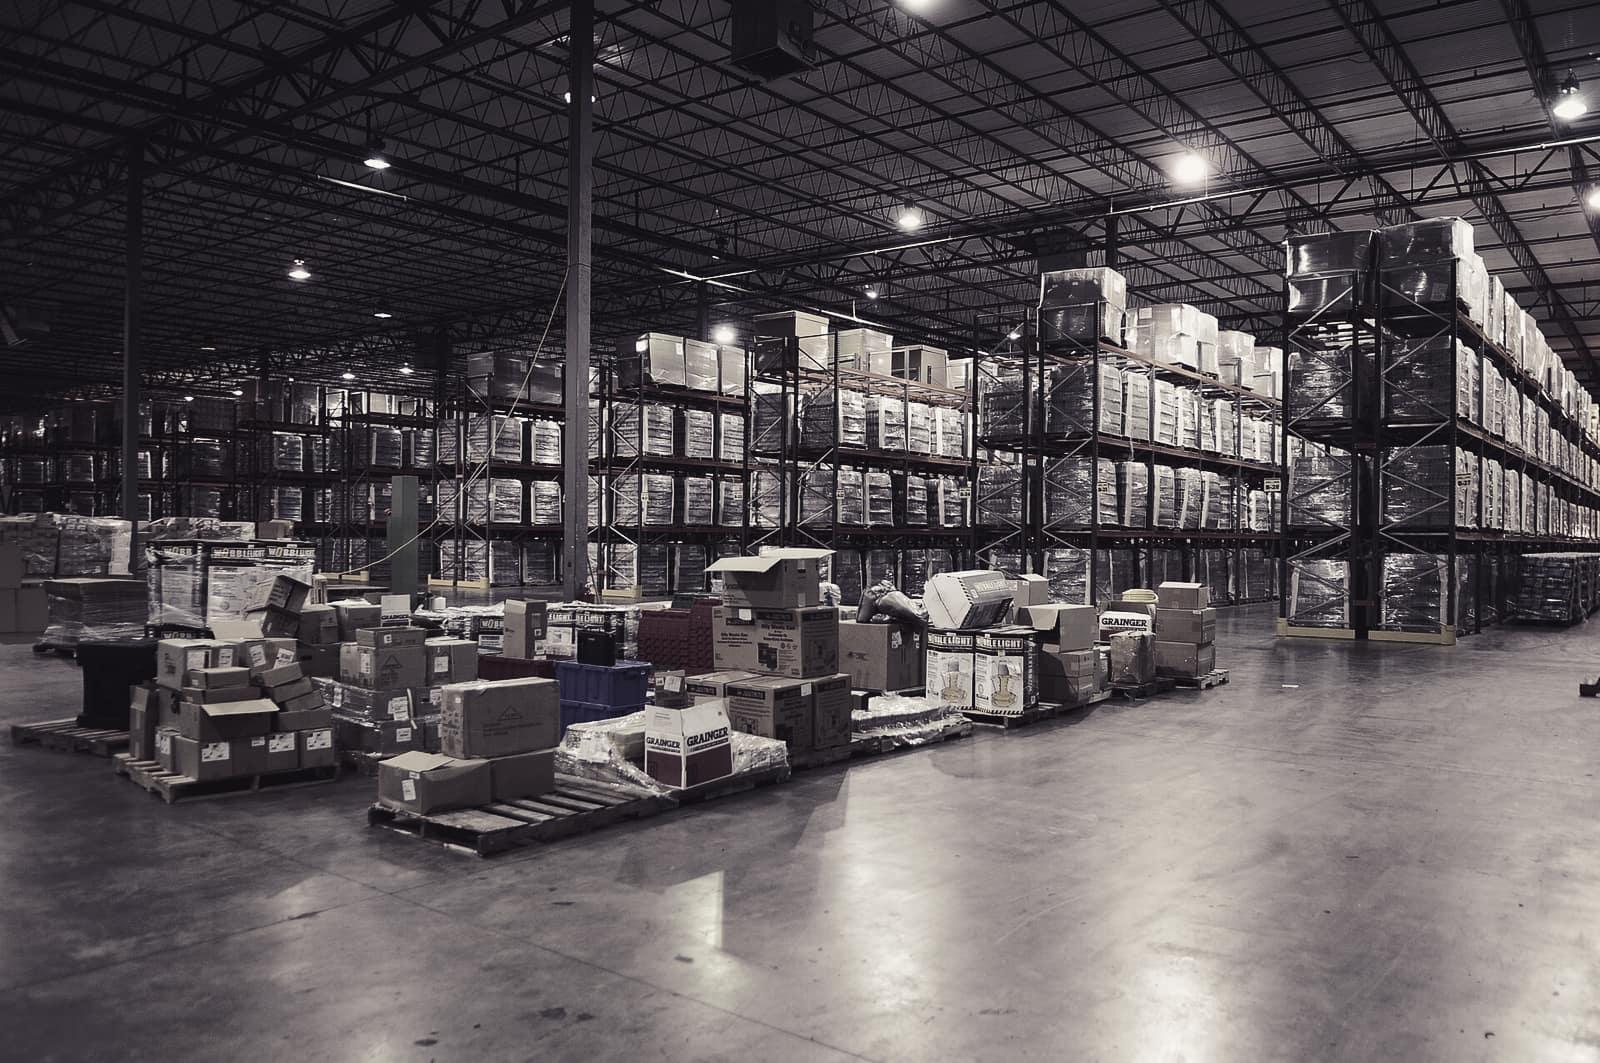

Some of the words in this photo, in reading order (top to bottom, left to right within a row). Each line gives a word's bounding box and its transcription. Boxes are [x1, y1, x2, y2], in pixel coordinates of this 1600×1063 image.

[1101, 617, 1147, 627] GRAINGER
[646, 736, 681, 749] GRAINGER
[686, 727, 729, 746] GRAINGER
